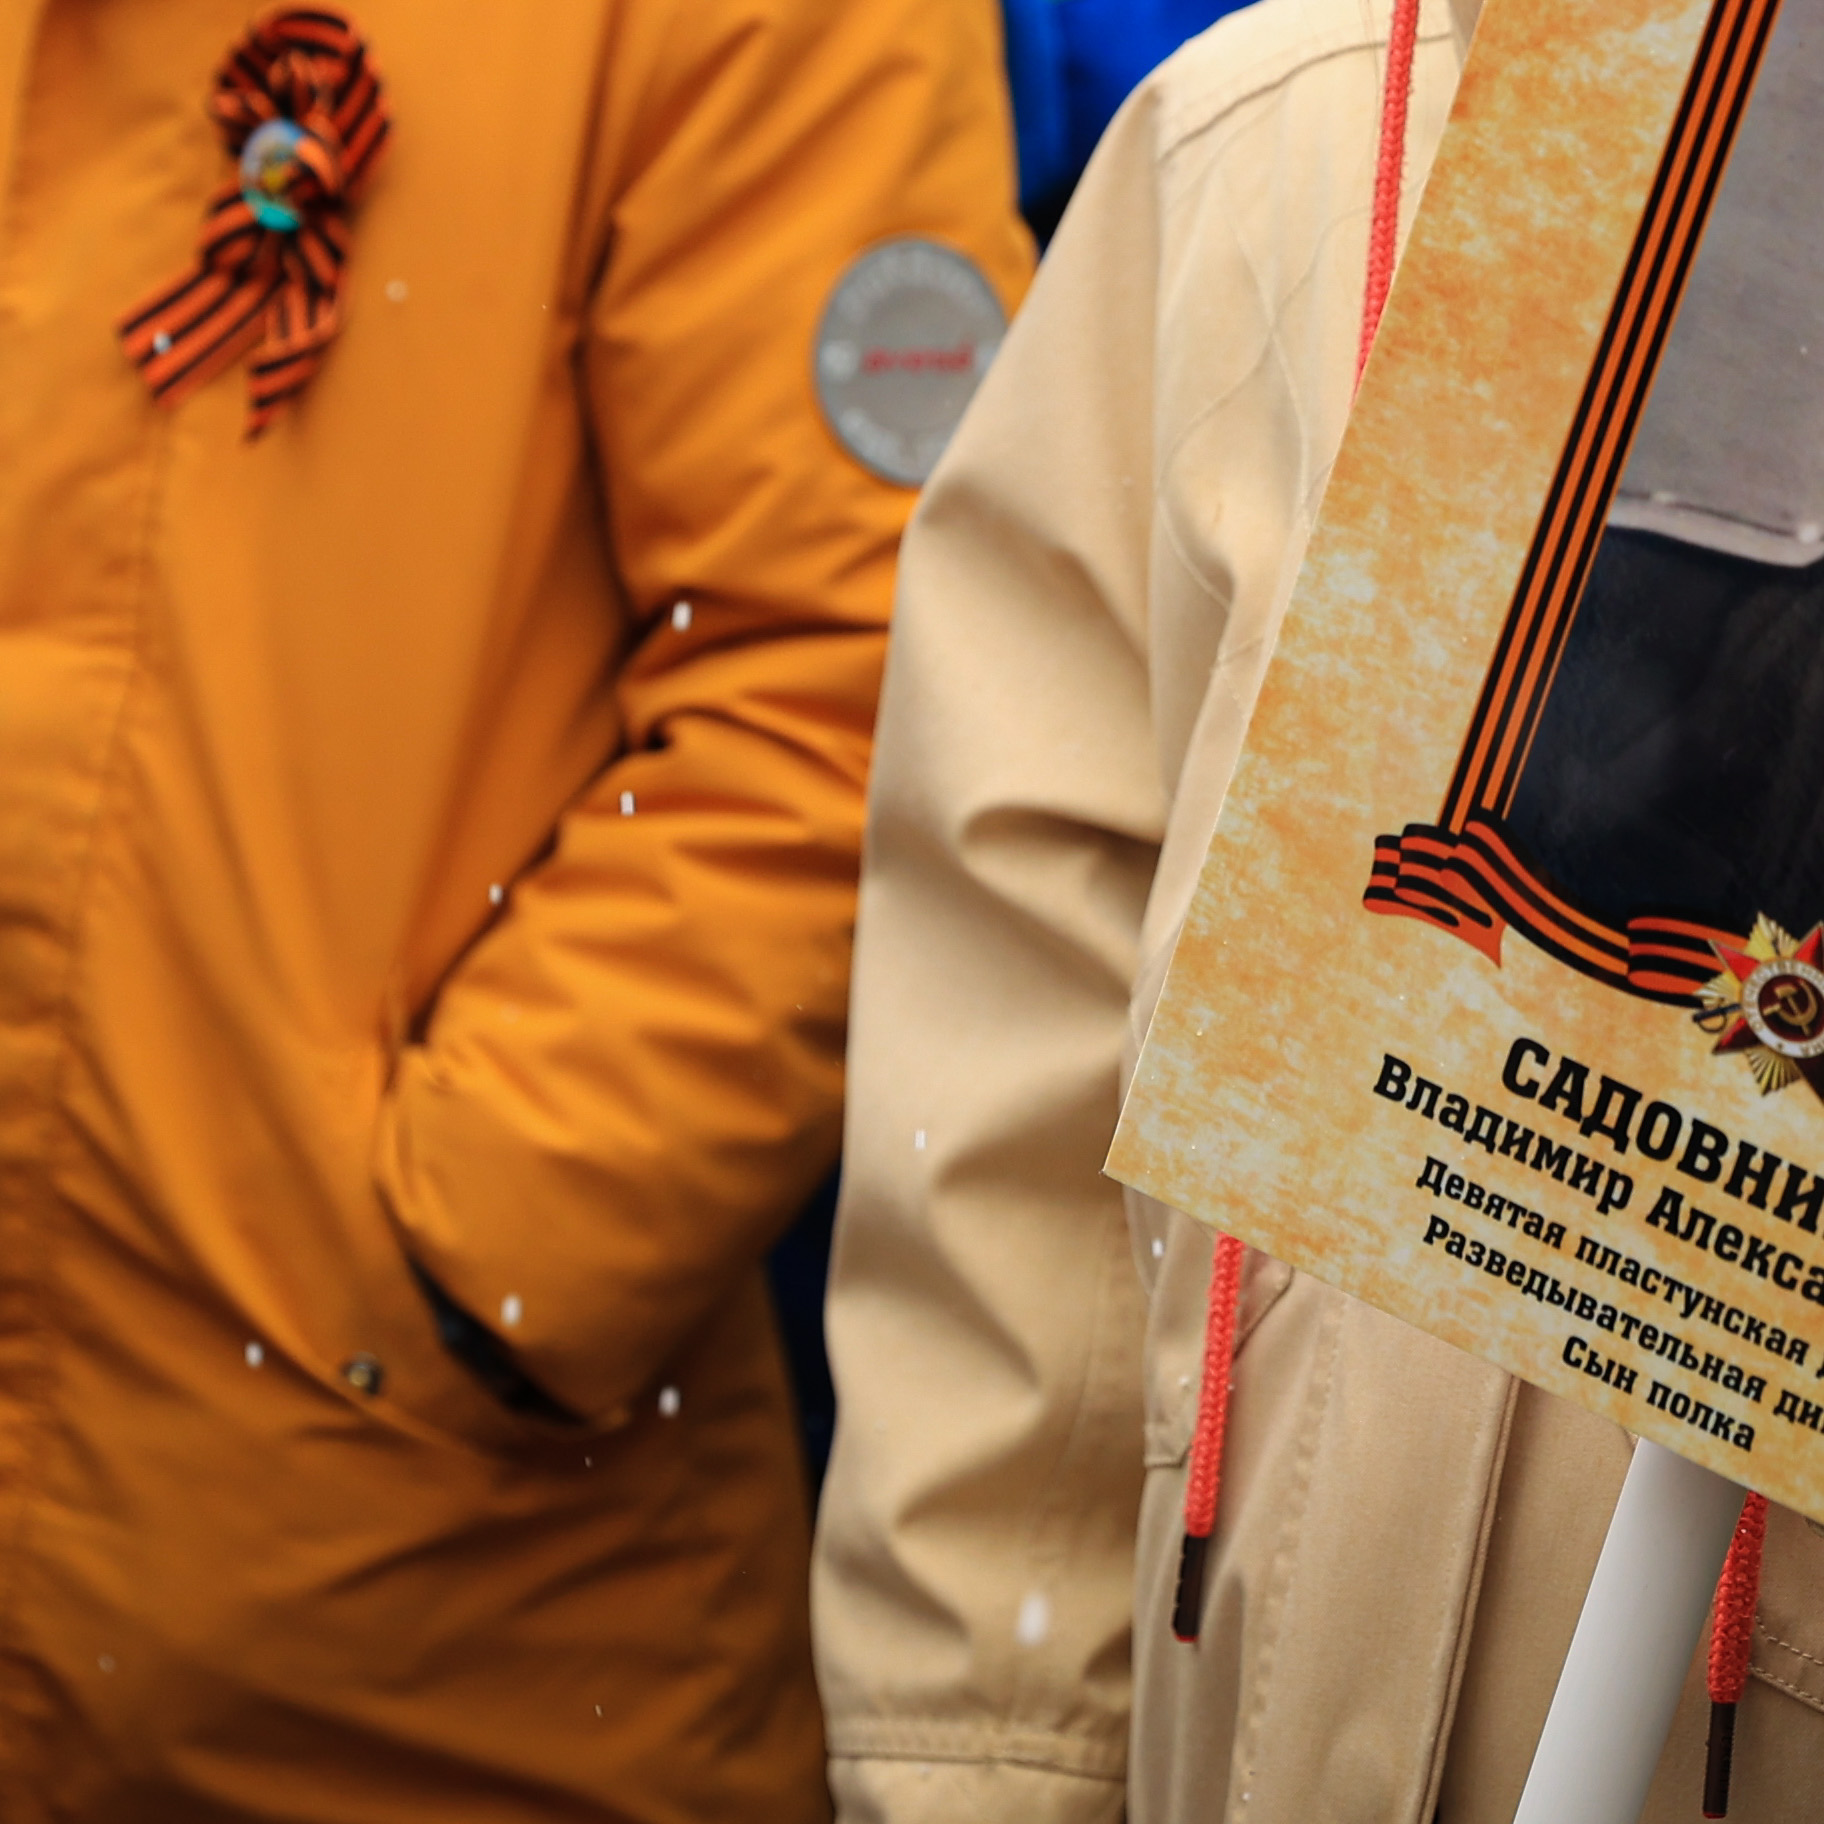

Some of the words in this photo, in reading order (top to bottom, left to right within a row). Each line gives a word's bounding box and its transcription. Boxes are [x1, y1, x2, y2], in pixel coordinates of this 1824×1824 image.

[1372, 1052, 1635, 1215] Владимир
[1414, 1154, 1568, 1251] Девятая
[1573, 1234, 1811, 1367] пластунская
[1422, 1213, 1769, 1405] Разведывательная
[1561, 1334, 1639, 1396] Сын
[1645, 1379, 1756, 1454] полка
